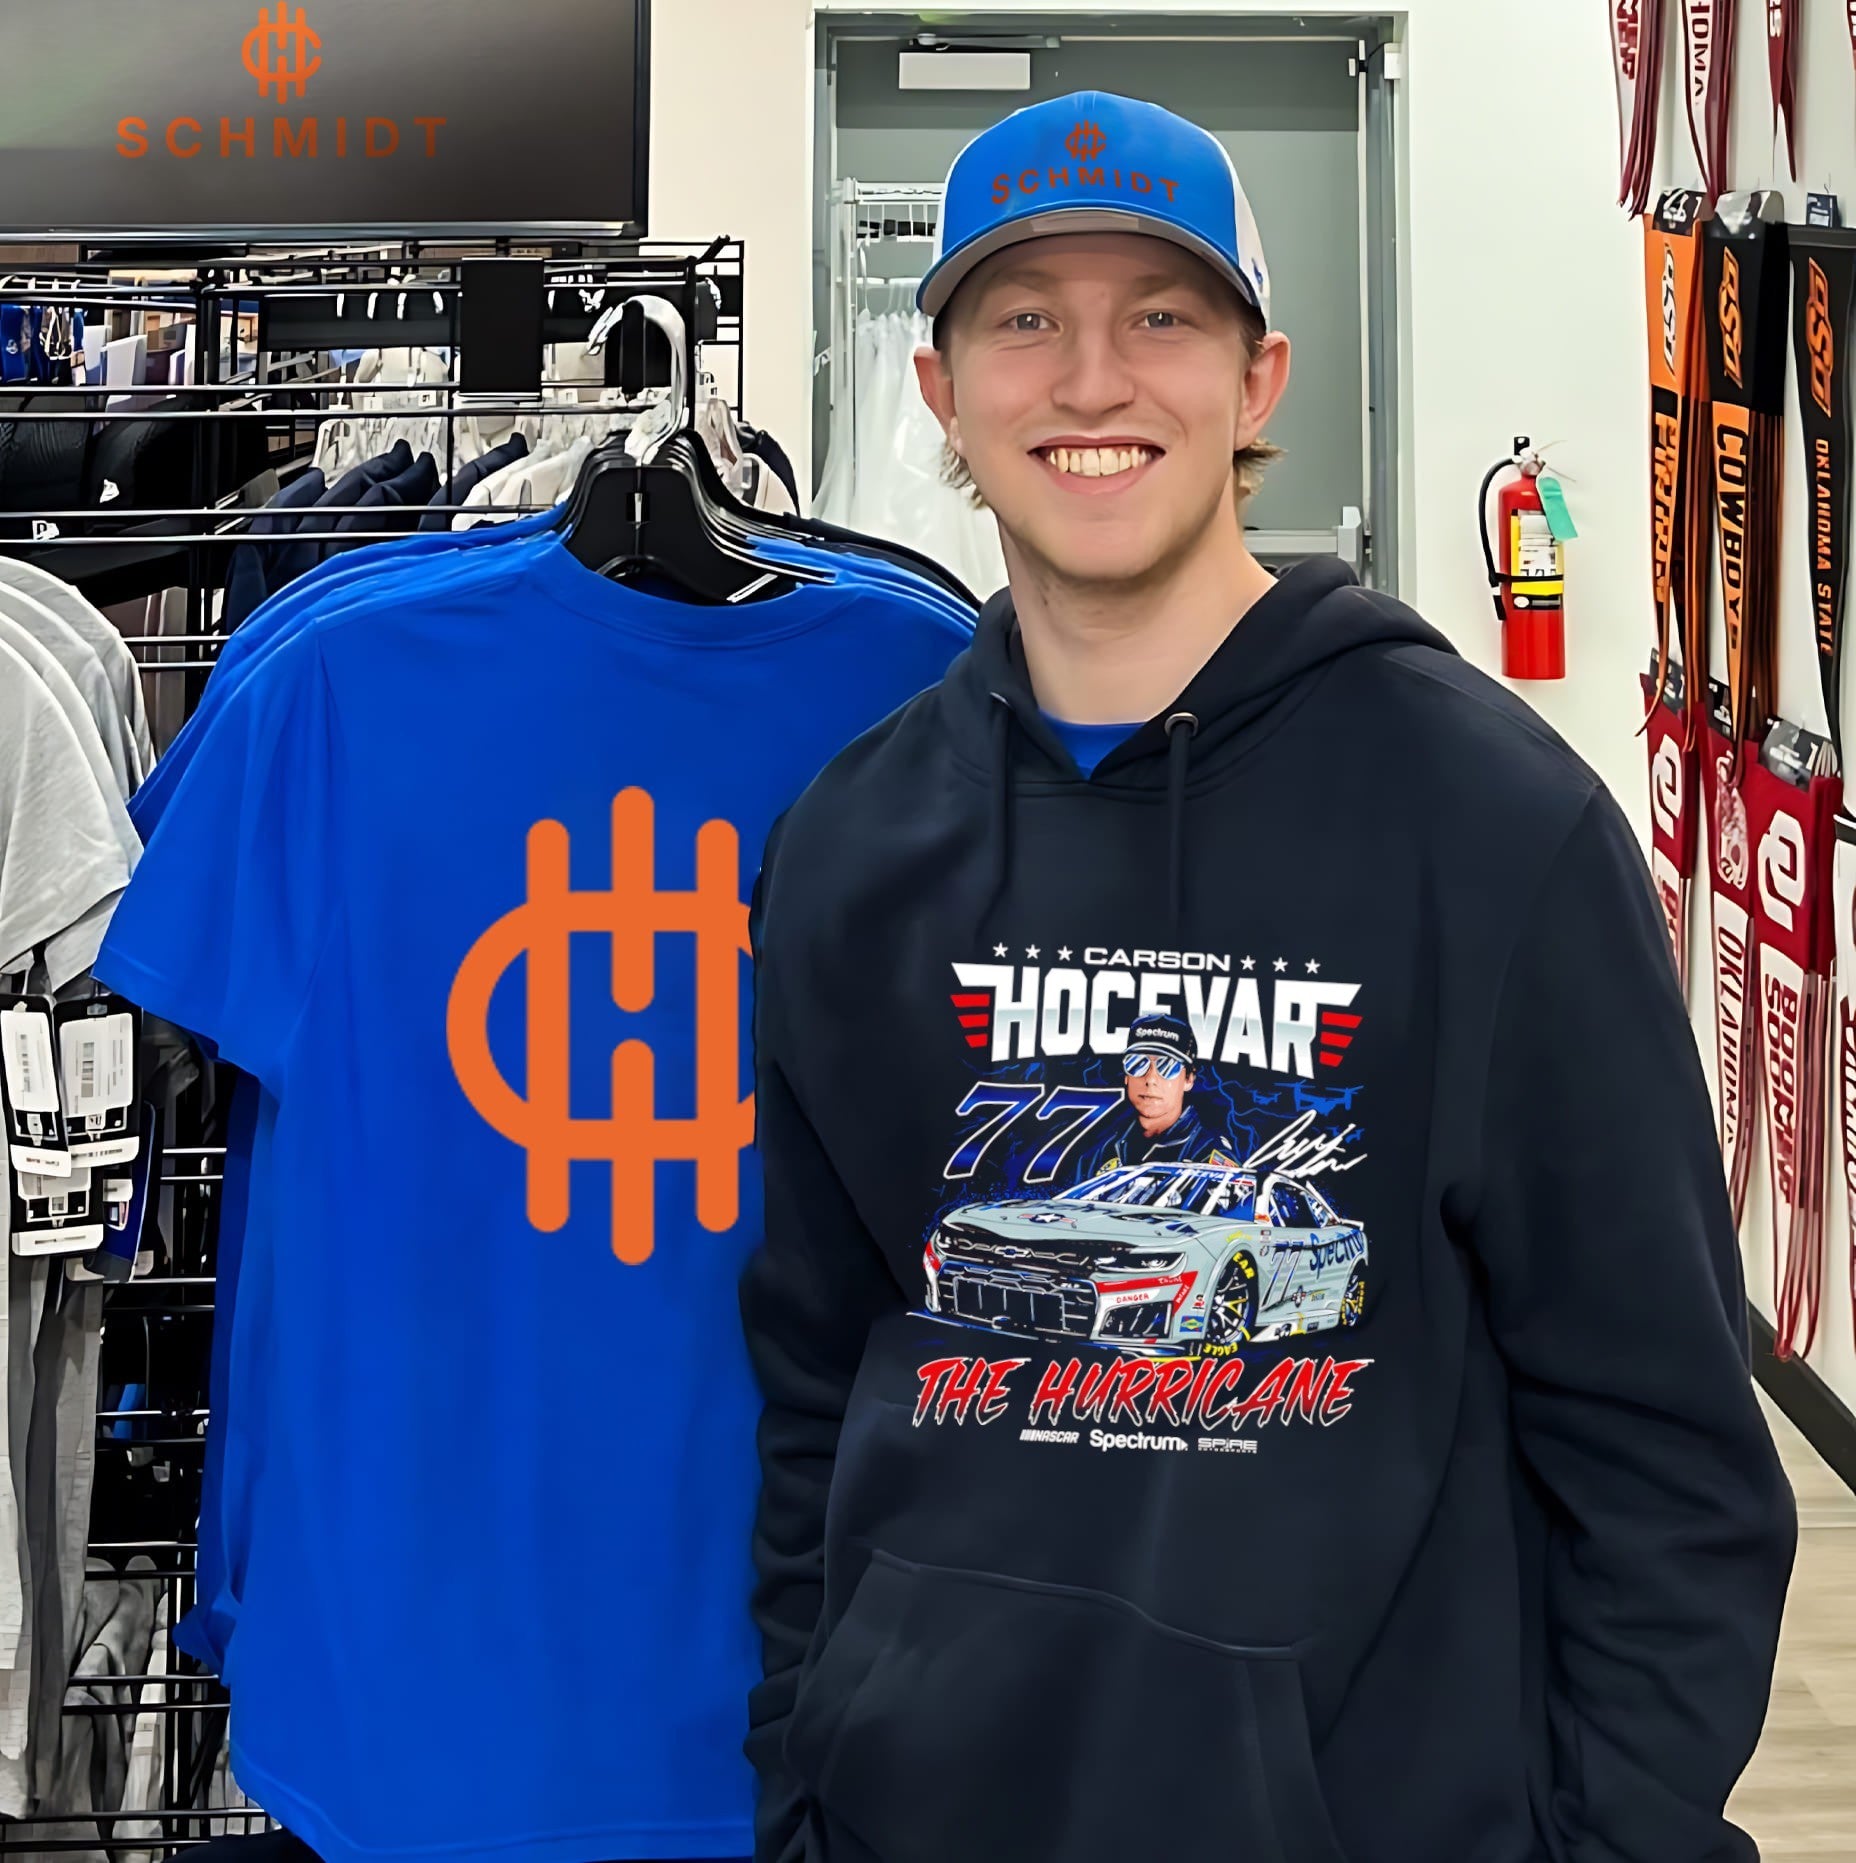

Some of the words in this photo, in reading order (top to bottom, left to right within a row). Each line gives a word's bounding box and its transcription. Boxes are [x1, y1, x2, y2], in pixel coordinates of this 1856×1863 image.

[115, 117, 448, 159] SCHMIDT
[991, 166, 1179, 204] SCHMIDT
[1083, 947, 1231, 972] CARSON
[951, 962, 1362, 1080] HOCEVAR
[1135, 1027, 1180, 1042] Spectrum
[1718, 926, 1745, 1144] OKLAHOMA
[943, 1081, 1126, 1185] 77
[1261, 1240, 1305, 1307] 77
[1116, 1292, 1150, 1304] DANGER
[1203, 1341, 1238, 1357] EAGLE
[912, 1357, 1032, 1428] THE
[1029, 1355, 1375, 1432] HURRICANE
[1028, 1430, 1080, 1444] NASCAR
[1089, 1428, 1182, 1452] Spectrum
